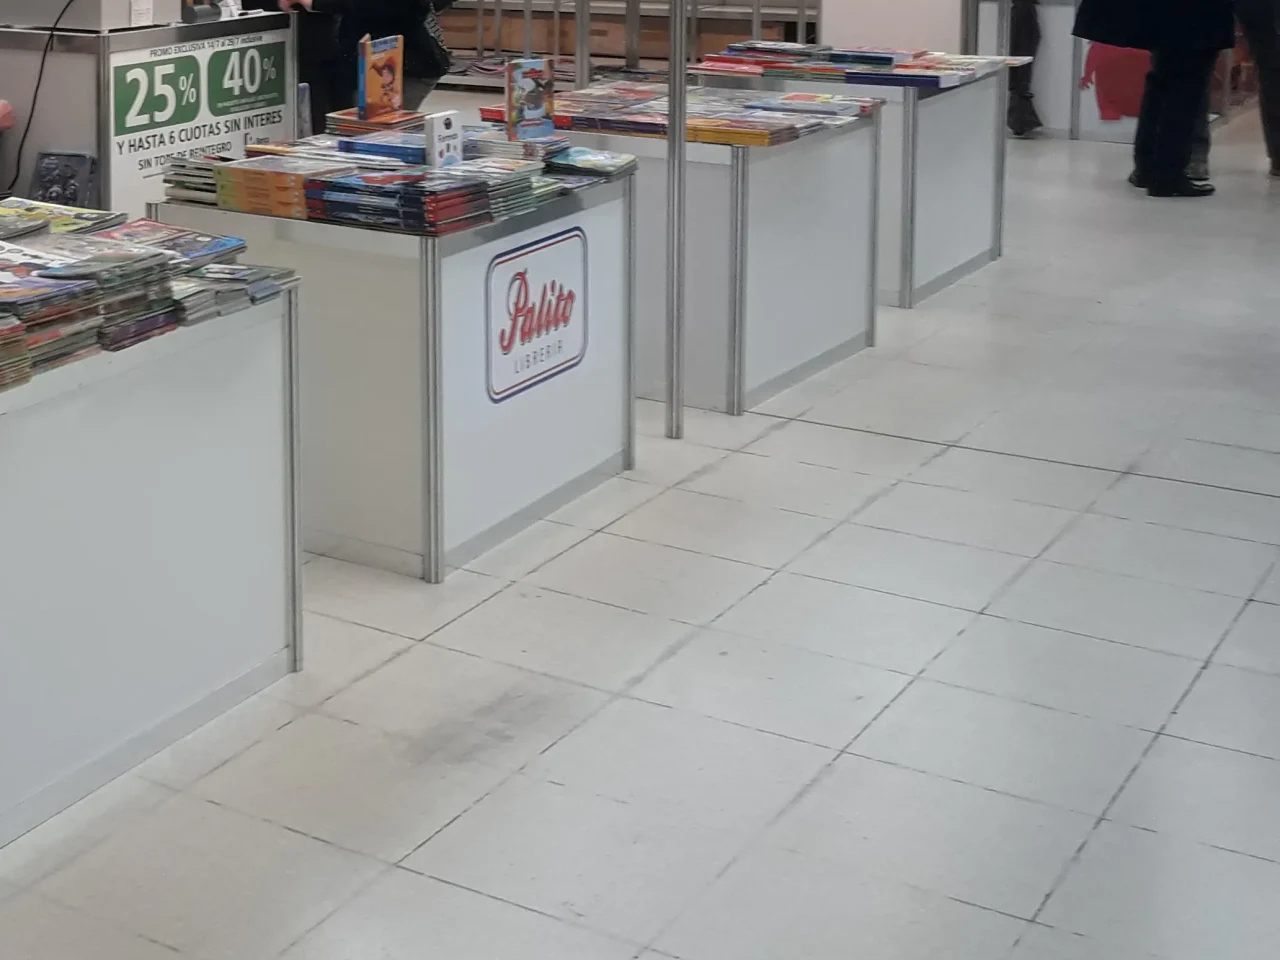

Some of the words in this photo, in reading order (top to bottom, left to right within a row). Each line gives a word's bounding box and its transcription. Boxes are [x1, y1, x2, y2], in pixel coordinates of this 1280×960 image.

[124, 63, 197, 129] 25%
[222, 47, 277, 96] 40%
[116, 141, 125, 156] Y
[128, 135, 167, 155] HASTA
[169, 132, 176, 146] 6
[177, 122, 221, 143] CUOTAS
[223, 118, 242, 134] SIN
[243, 110, 283, 131] INTERES
[137, 157, 152, 171] SIN
[499, 267, 576, 356] Palito
